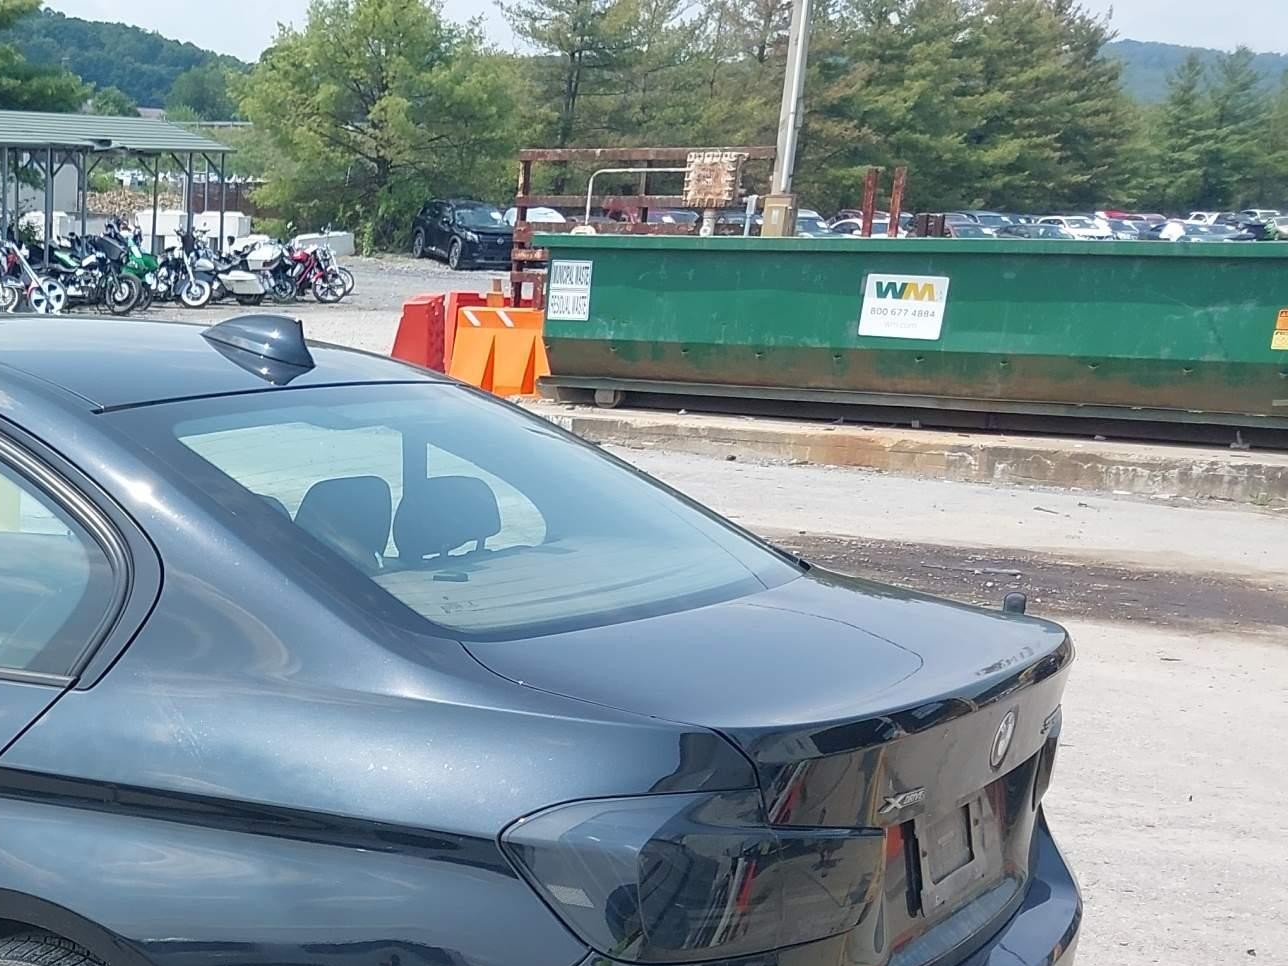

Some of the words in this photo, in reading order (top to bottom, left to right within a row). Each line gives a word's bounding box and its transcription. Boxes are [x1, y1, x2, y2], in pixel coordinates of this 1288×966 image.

[552, 265, 574, 286] MUNICIPAL
[575, 265, 590, 286] WASTE
[876, 281, 935, 302] WM
[572, 295, 587, 315] WASTE
[870, 307, 889, 316] 800
[890, 308, 909, 317] 677
[911, 309, 936, 318] 4884
